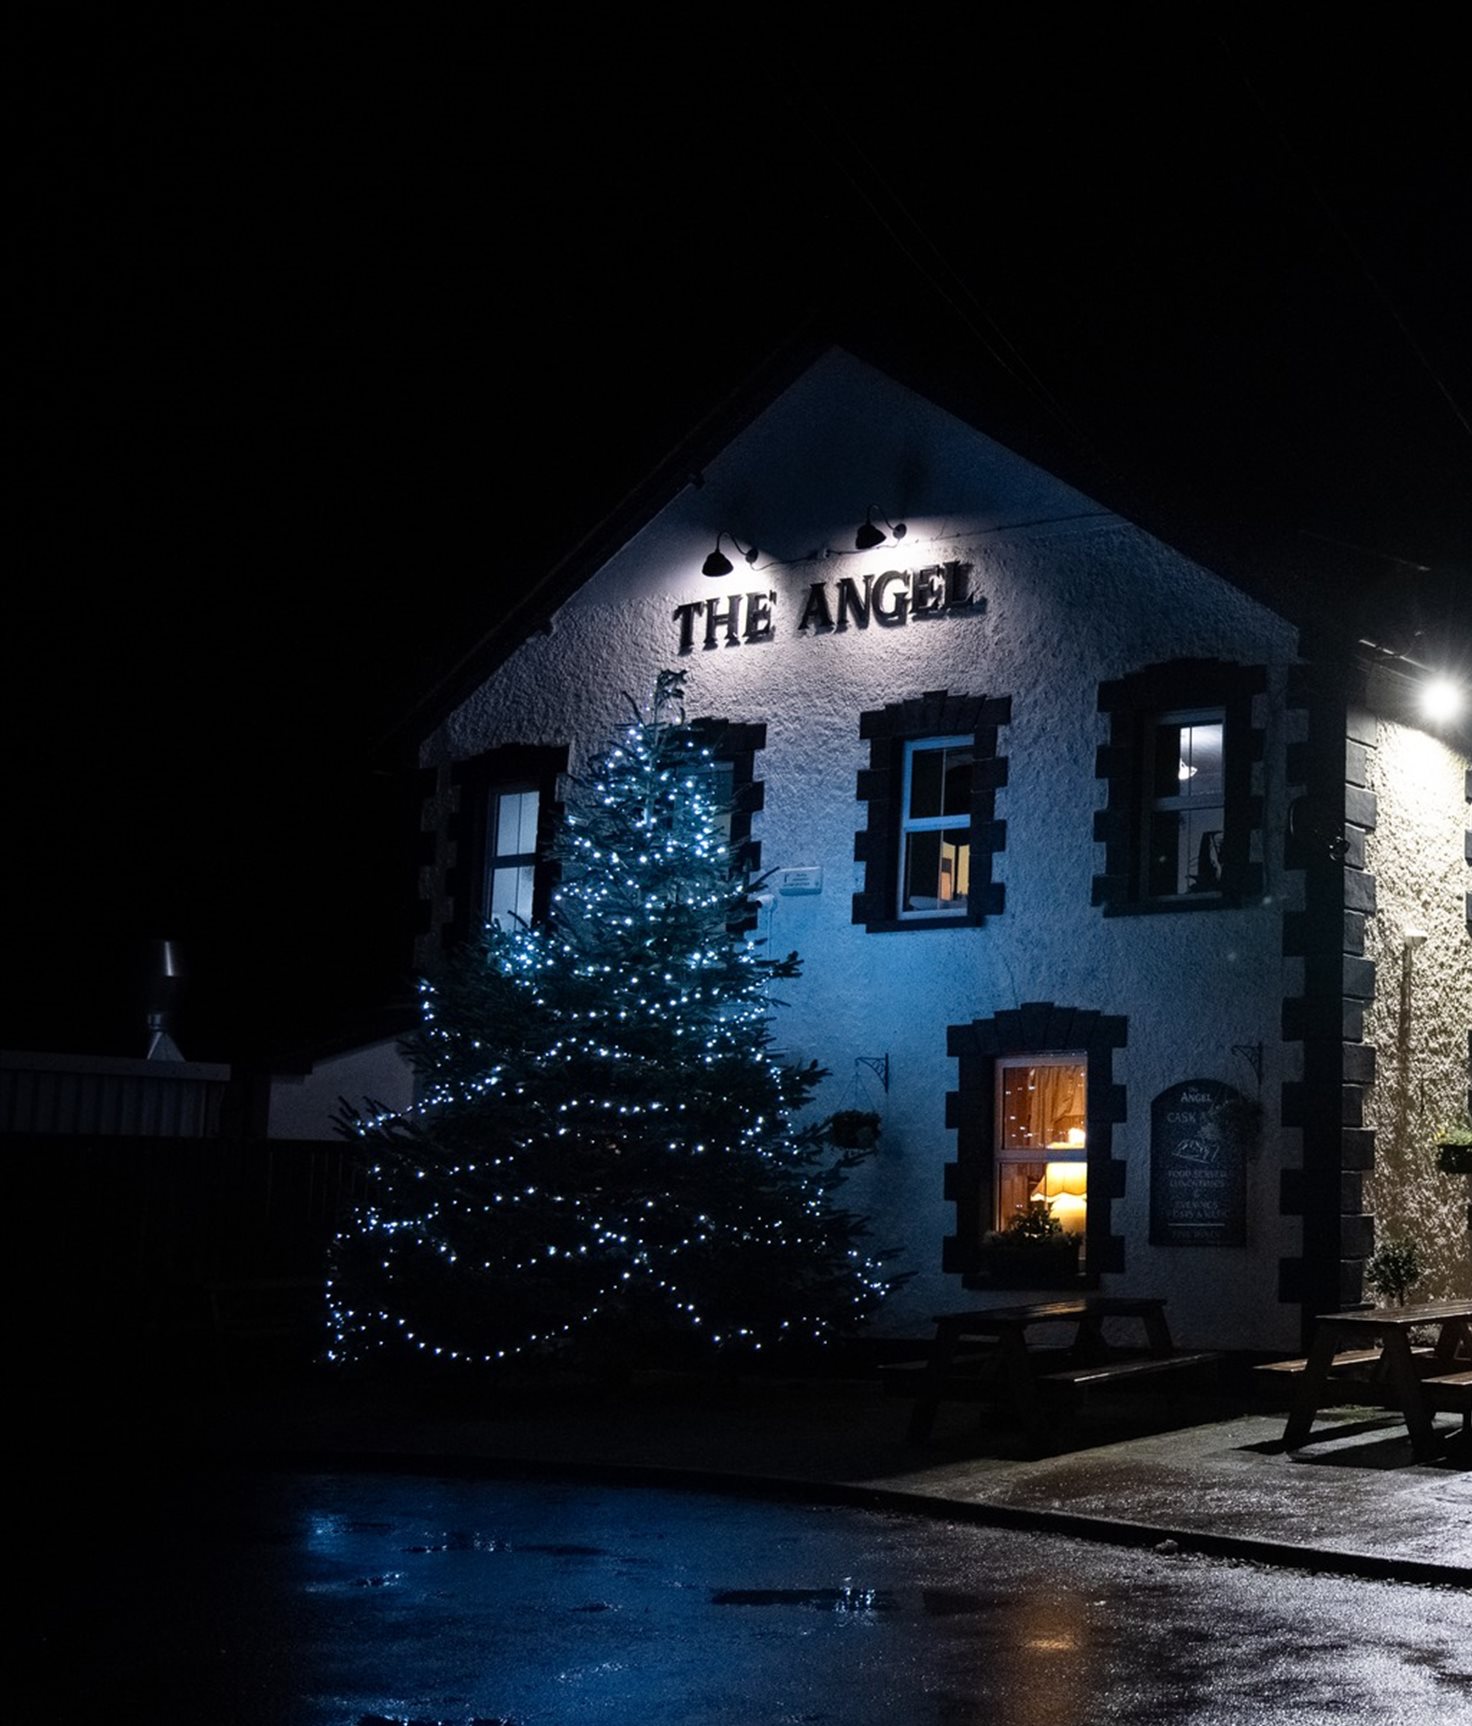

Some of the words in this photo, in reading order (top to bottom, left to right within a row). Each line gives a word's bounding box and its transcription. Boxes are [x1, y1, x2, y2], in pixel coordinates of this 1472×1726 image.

[673, 587, 778, 656] THE
[797, 558, 980, 634] ANGEL
[1180, 1091, 1213, 1103] ANGEL
